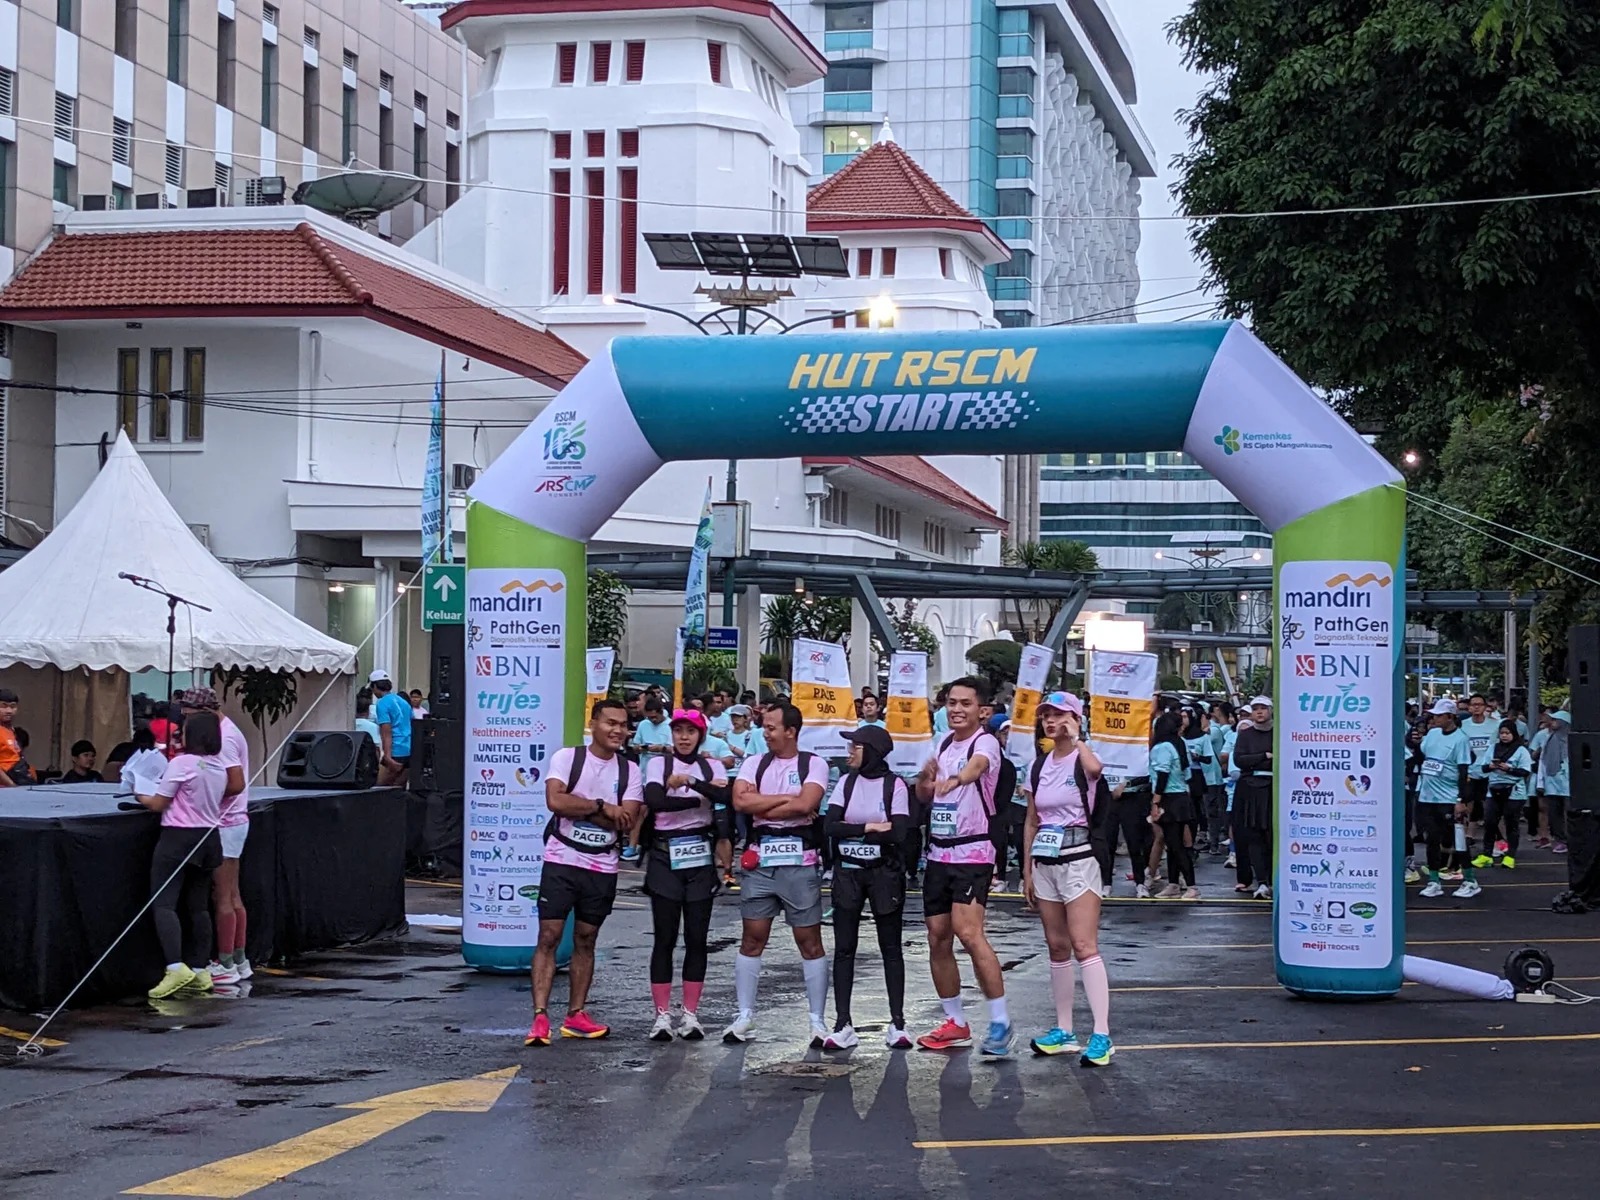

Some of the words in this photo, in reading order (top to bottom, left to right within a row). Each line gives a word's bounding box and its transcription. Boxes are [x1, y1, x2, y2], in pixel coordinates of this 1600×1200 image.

[788, 352, 893, 389] HUT
[894, 348, 1038, 386] RSCM
[554, 411, 576, 422] RSCM
[847, 392, 972, 432] START
[1242, 432, 1292, 440] Kemenkes
[469, 592, 542, 612] mandiri
[1285, 586, 1370, 608] mandiri
[426, 611, 462, 620] Keluar
[491, 621, 560, 634] PathGen
[1314, 616, 1388, 632] PathGen
[495, 656, 541, 677] BNI
[1320, 655, 1370, 678] BNI
[1104, 701, 1130, 714] PACE
[486, 717, 531, 725] SIEMENS
[1310, 720, 1361, 729] SIEMENS
[472, 727, 531, 737] Healthineers
[1292, 732, 1361, 742] Healthineers
[478, 744, 521, 753] UNITED
[1300, 749, 1350, 758] UNITED
[474, 754, 521, 763] IMAGING
[1294, 761, 1351, 770] IMAGING
[472, 787, 505, 795] PEDULI
[1291, 796, 1334, 805] PEDULI
[477, 816, 498, 824] CIBIS
[502, 815, 532, 824] Prove
[1300, 827, 1326, 836] CIBIS
[1330, 826, 1364, 837] Prove
[573, 831, 607, 843] PACER
[674, 842, 707, 856] PACER
[764, 844, 798, 854] PACER
[843, 846, 875, 856] PACER
[478, 922, 497, 931] meiji
[1302, 941, 1327, 951] meiji
